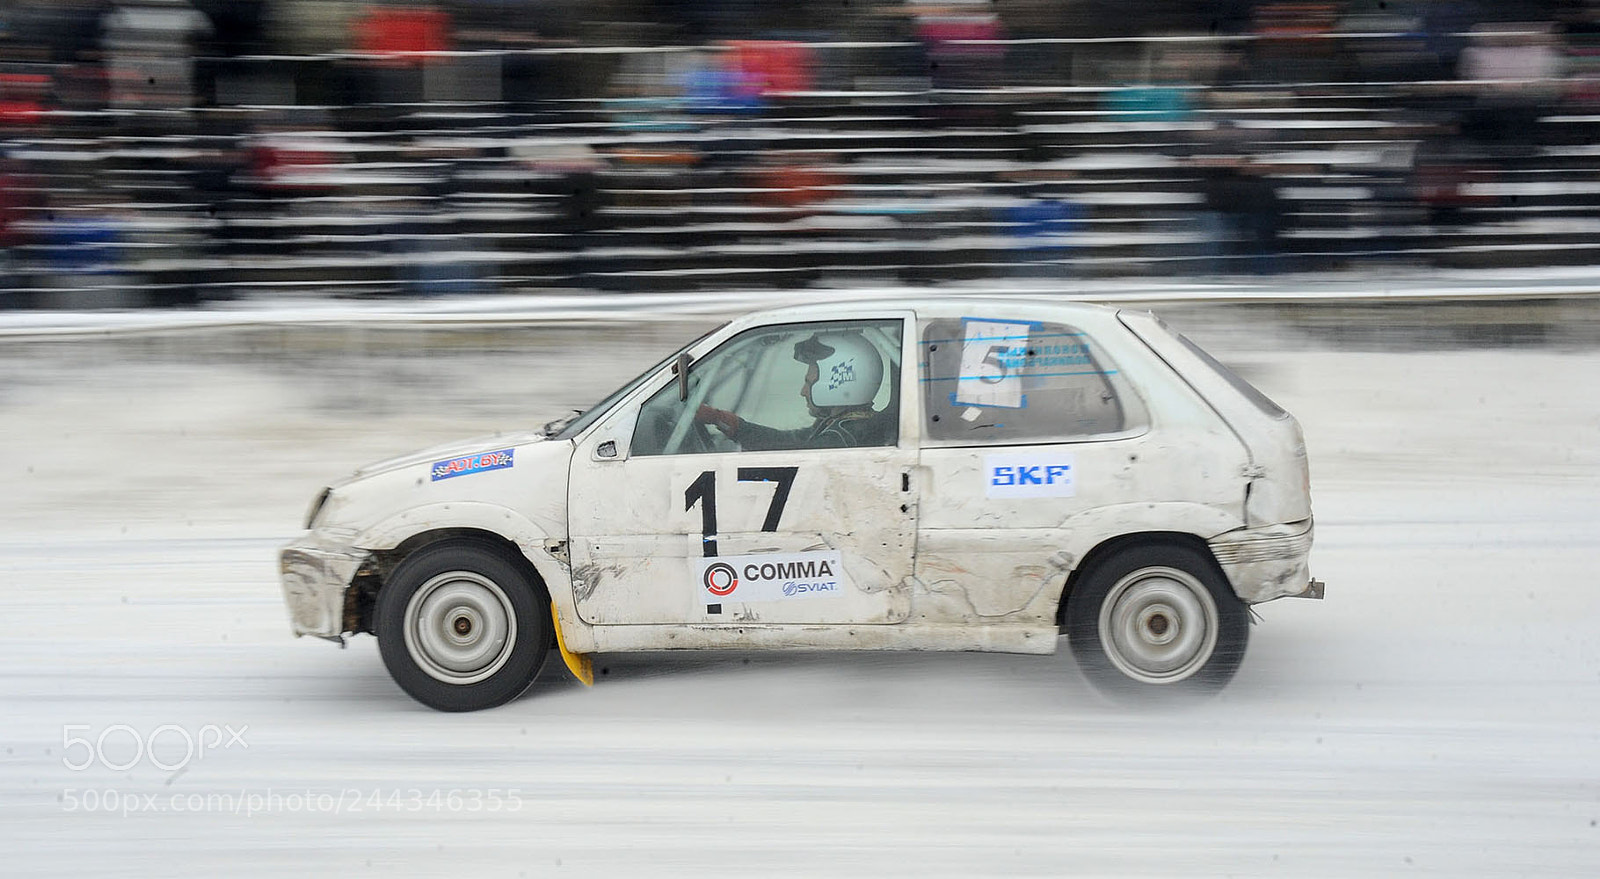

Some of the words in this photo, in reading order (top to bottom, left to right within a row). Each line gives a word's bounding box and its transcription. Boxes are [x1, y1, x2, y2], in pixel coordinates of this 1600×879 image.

[979, 345, 1010, 385] 5
[992, 465, 1070, 486] SKF
[685, 466, 799, 559] 17
[743, 560, 834, 582] COMMA
[797, 581, 837, 593] SVIAT
